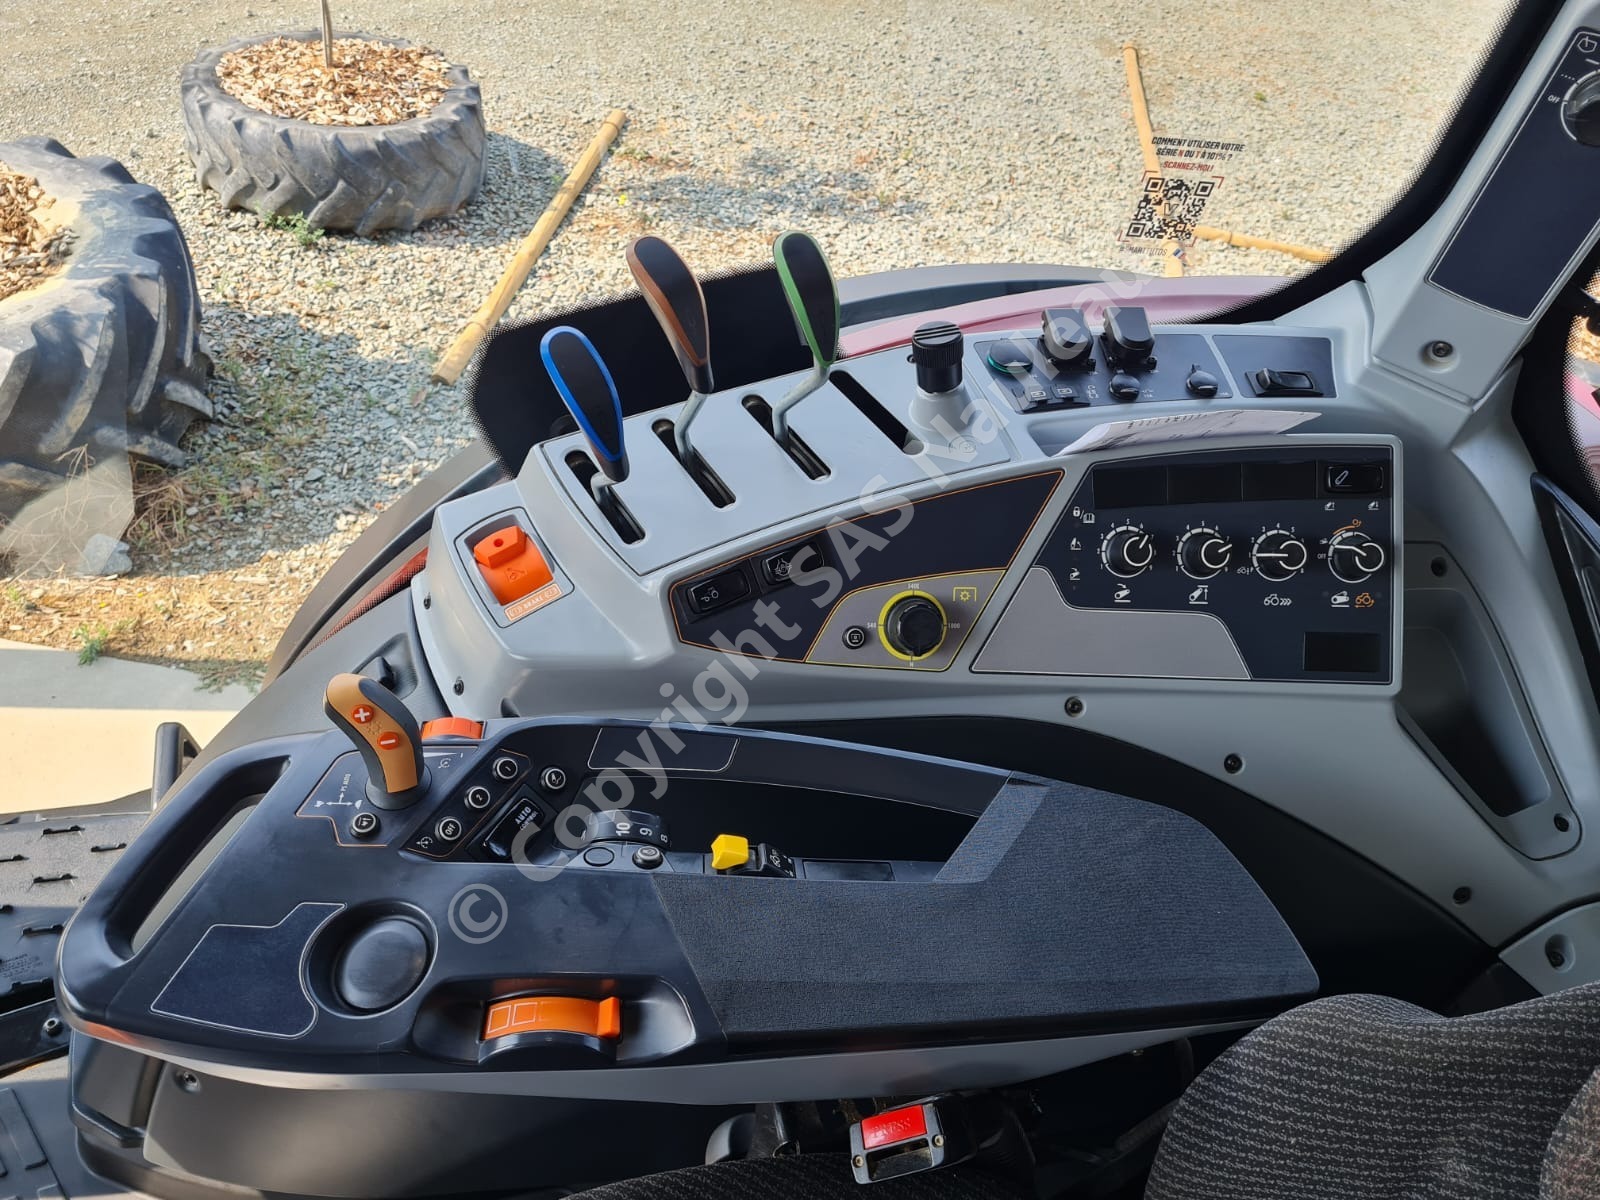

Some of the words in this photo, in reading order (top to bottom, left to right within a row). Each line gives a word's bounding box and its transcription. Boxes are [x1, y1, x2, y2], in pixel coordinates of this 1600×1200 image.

[1151, 136, 1187, 147] COMMENT
[1187, 139, 1221, 150] UTILISER
[1220, 143, 1246, 152] VOTRE
[1156, 146, 1178, 157] SÉRIE
[1184, 150, 1195, 158] OU
[1195, 151, 1201, 159] T
[615, 822, 630, 836] 10
